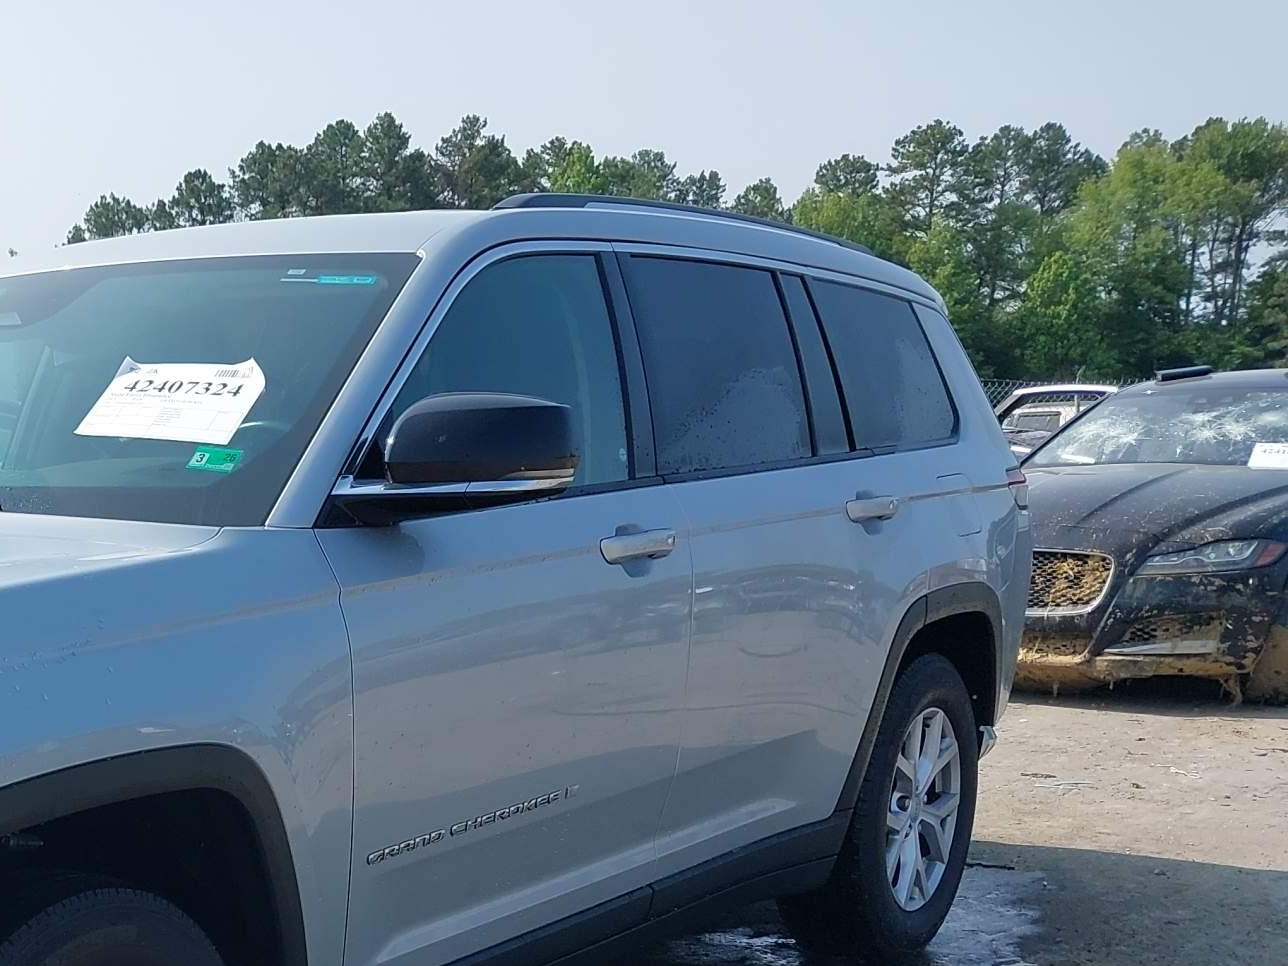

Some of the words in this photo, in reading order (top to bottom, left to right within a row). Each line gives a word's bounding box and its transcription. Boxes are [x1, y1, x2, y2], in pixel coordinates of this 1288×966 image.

[124, 379, 245, 398] 42407324
[195, 453, 206, 464] 3
[366, 829, 446, 866] GRAND
[450, 789, 562, 837] CHEROKEE
